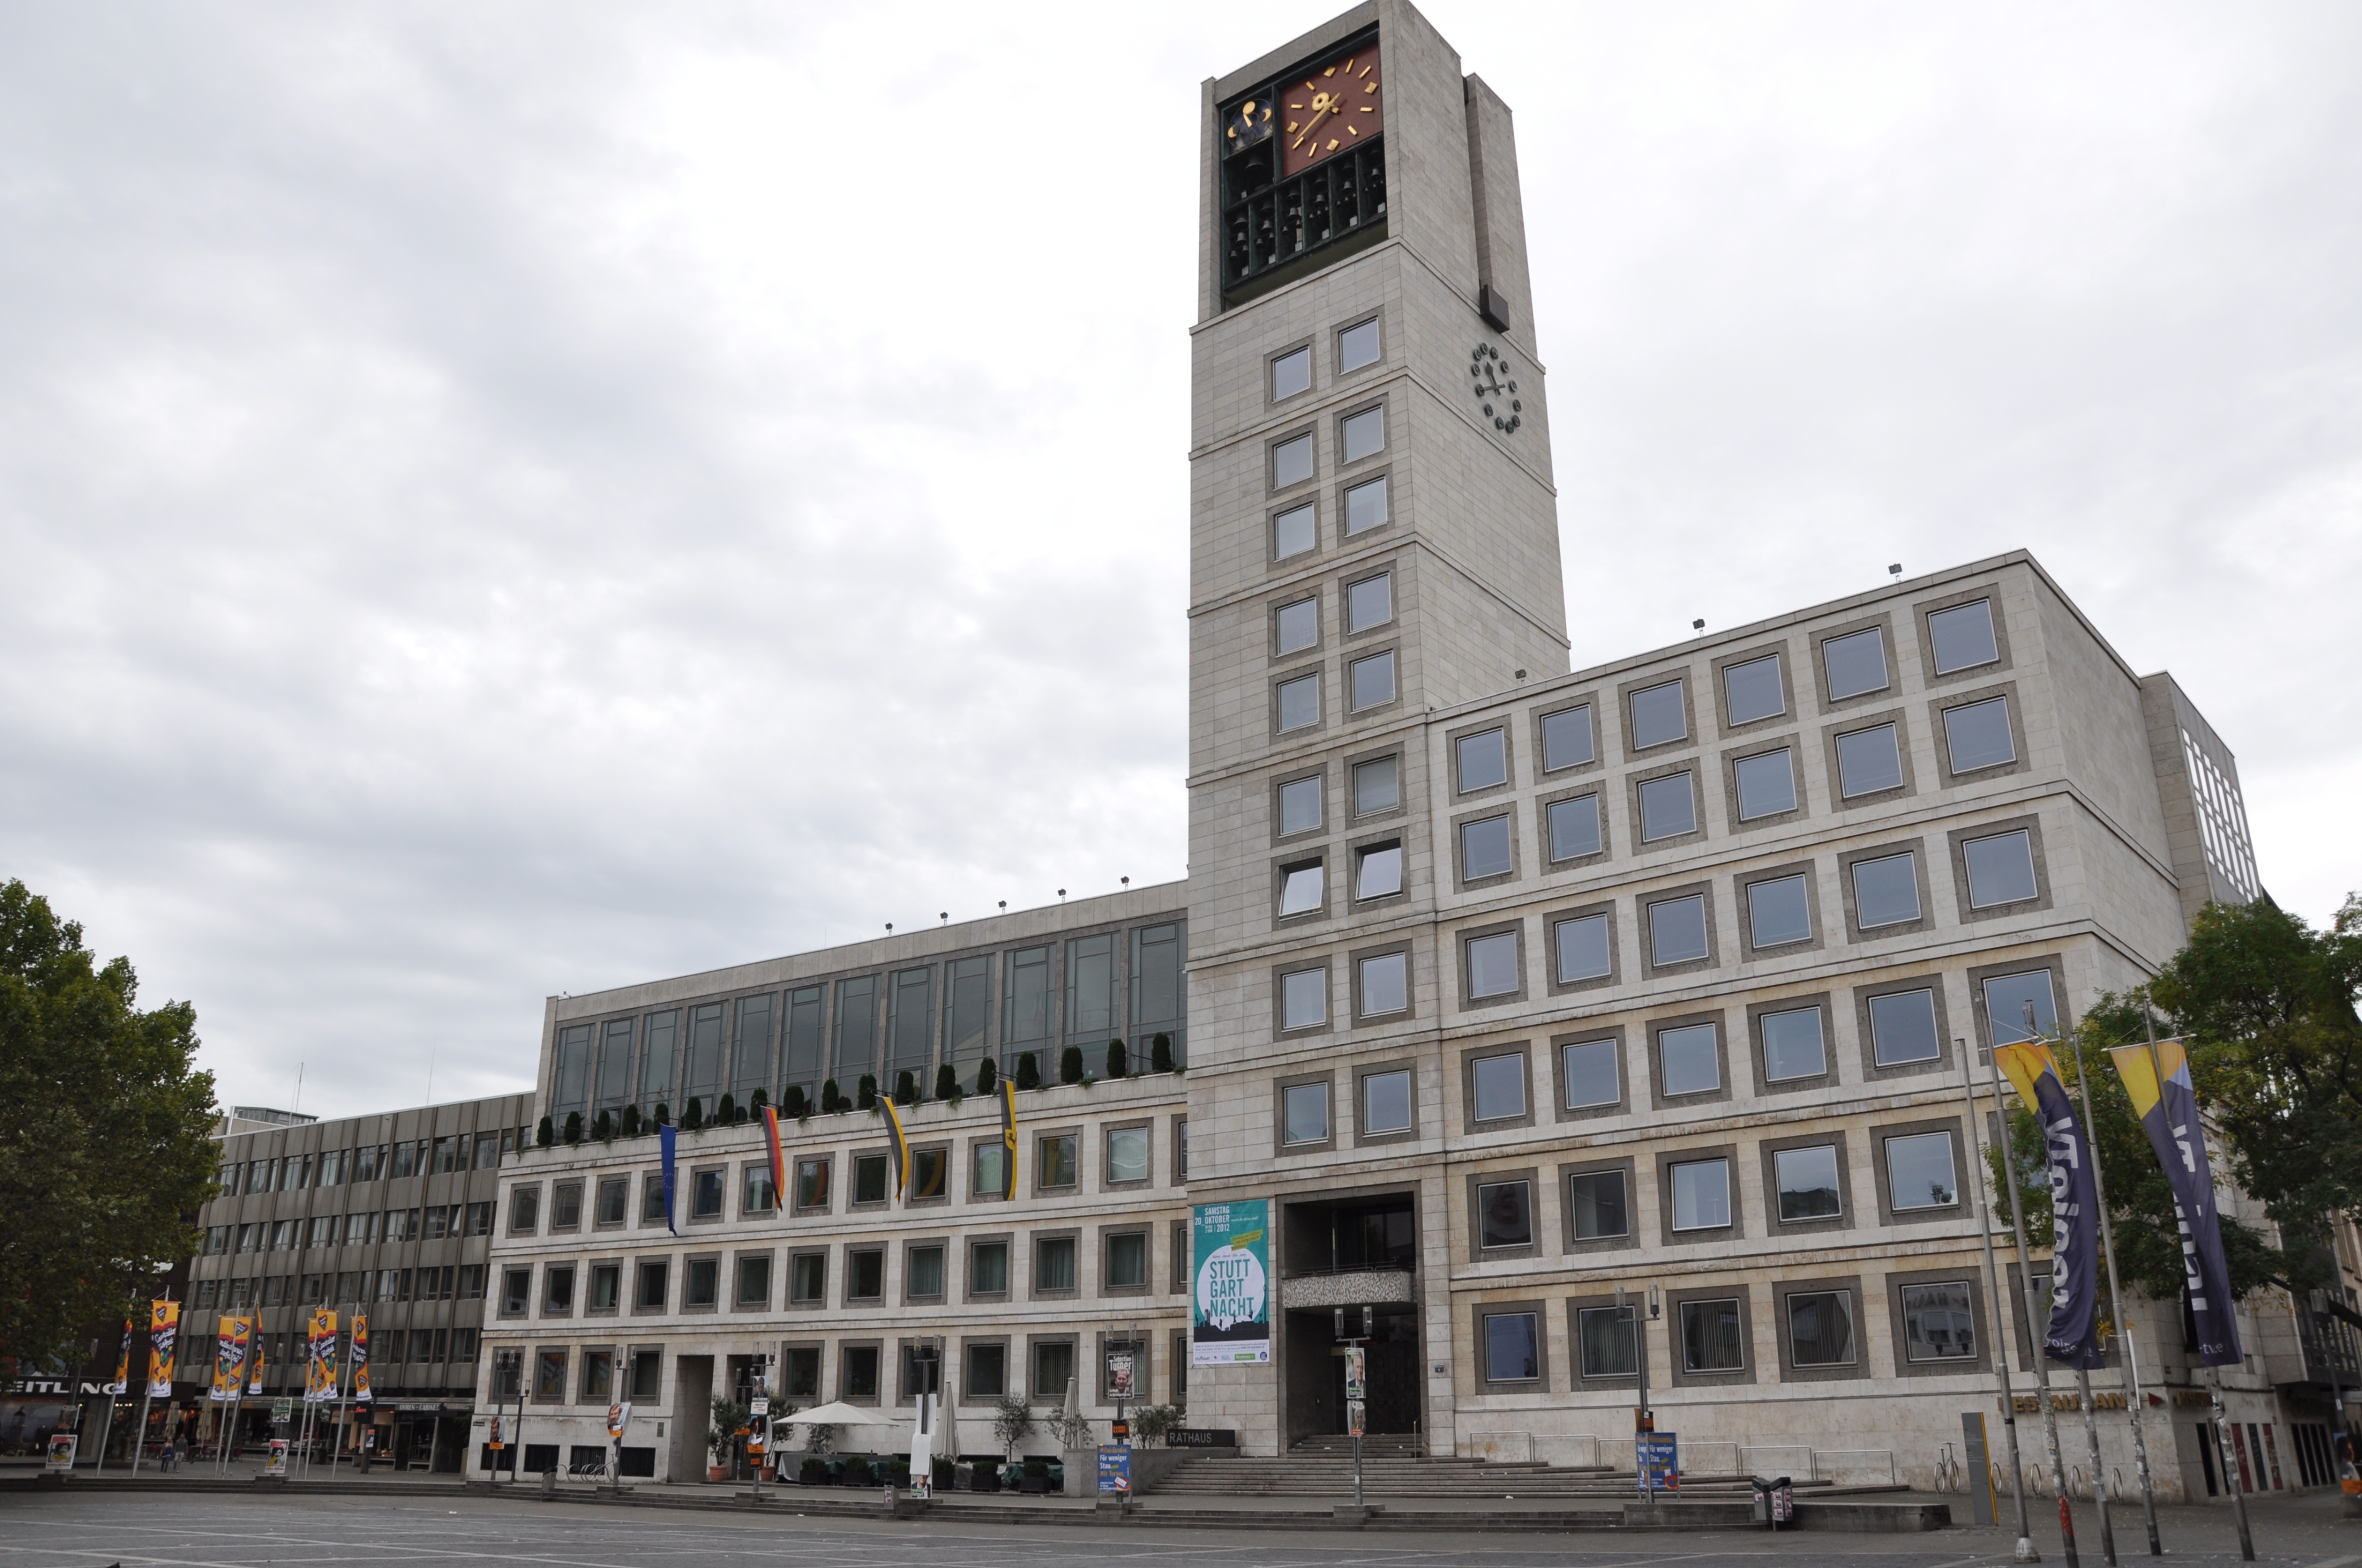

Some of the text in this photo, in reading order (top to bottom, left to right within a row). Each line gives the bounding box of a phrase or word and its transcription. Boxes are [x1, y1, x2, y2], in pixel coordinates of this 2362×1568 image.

[1204, 1206, 1230, 1216] SAMSTAG
[1204, 1214, 1230, 1224] OKTOBER
[1216, 1223, 1230, 1232] 2012
[1210, 1258, 1250, 1279] STUTT
[1210, 1279, 1244, 1298] GART
[1210, 1297, 1254, 1318] NACHT
[1109, 1359, 1132, 1371] Turner
[1169, 1432, 1212, 1443] RATHAUS
[1656, 1444, 1673, 1454] weniger
[1108, 1454, 1127, 1462] weniger
